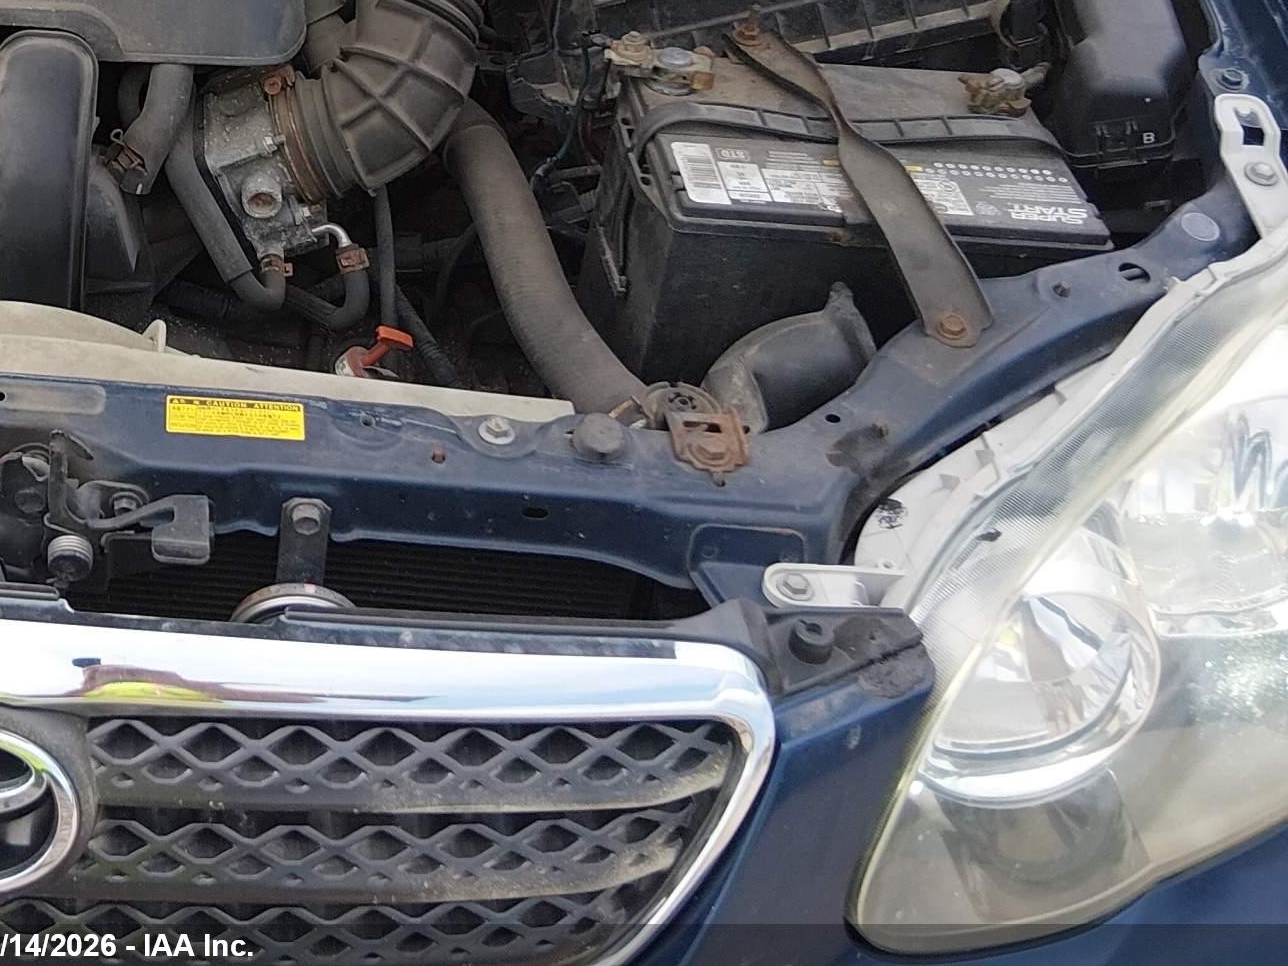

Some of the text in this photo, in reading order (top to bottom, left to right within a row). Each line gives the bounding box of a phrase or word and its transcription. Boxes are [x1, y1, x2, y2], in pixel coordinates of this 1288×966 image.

[1143, 132, 1155, 144] B
[1008, 202, 1088, 219] START
[1011, 212, 1083, 224] SUPER
